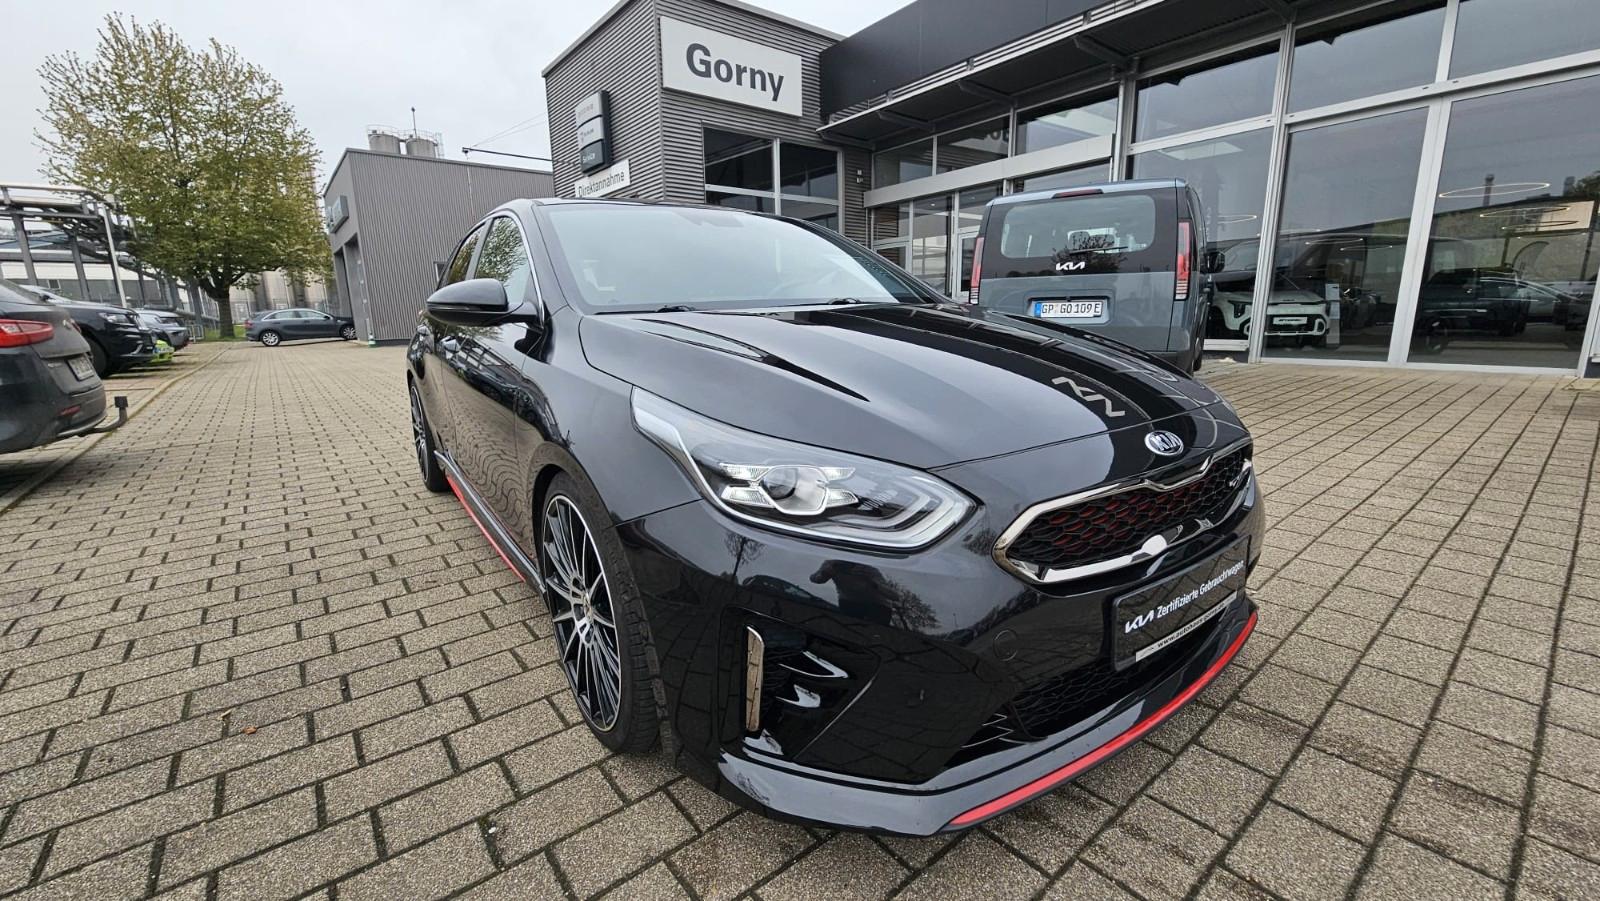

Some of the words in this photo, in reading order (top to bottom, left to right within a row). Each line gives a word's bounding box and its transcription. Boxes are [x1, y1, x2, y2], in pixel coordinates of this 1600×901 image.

[685, 42, 785, 102] Gorny
[578, 171, 625, 196] Direktannahme
[1055, 261, 1086, 271] KIA
[1042, 303, 1054, 314] GP
[1124, 609, 1154, 634] KIA
[1156, 588, 1199, 619] Zertifizierte
[1199, 560, 1245, 595] Gebrauchtwagen
